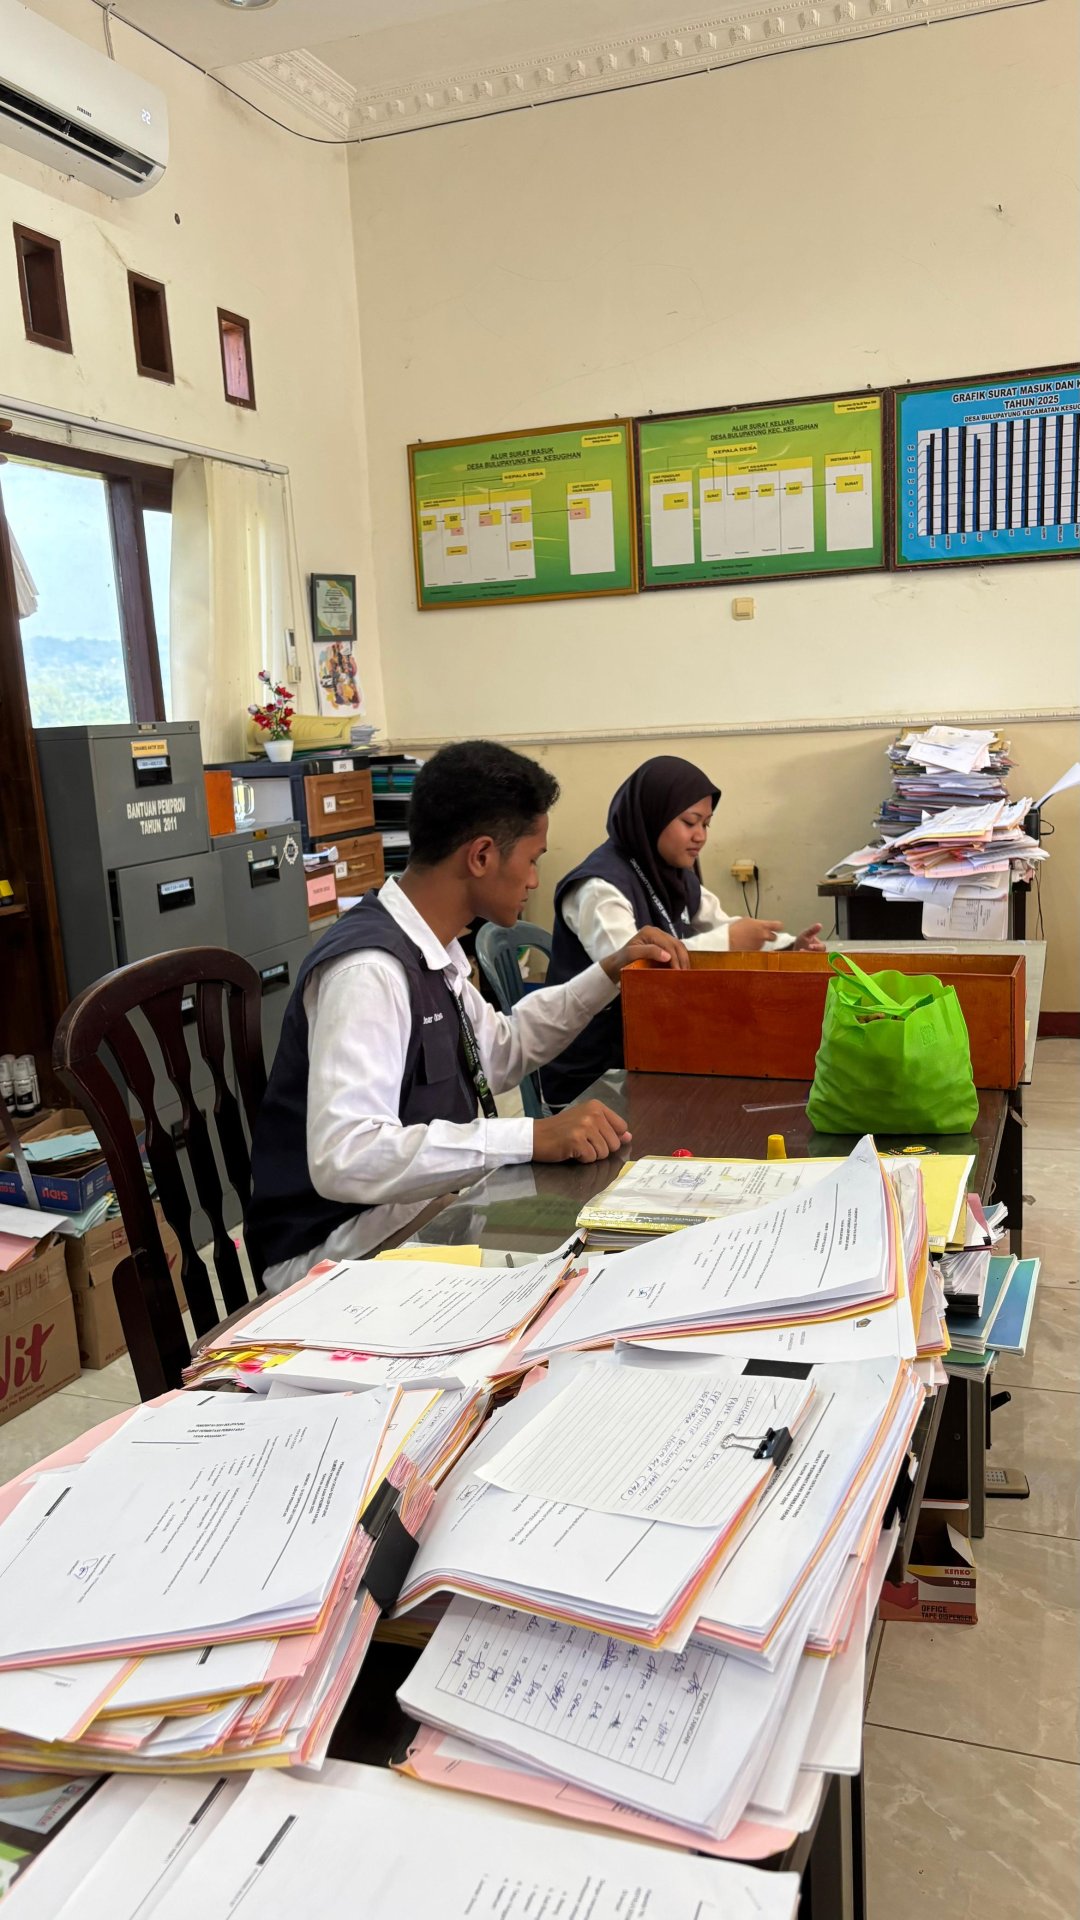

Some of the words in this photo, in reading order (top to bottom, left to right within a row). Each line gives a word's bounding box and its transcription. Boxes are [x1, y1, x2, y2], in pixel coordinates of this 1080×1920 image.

[141, 108, 151, 125] 22
[953, 391, 985, 402] GRAFIK
[988, 388, 1017, 398] SURAT
[1020, 382, 1053, 394] MASUK
[1055, 380, 1074, 390] DAN
[1004, 398, 1035, 409] TAHUN
[1037, 395, 1059, 405] 2025
[982, 411, 1021, 420] BULUPAYUNG
[1022, 406, 1060, 416] KECAMATAN
[728, 428, 767, 439] BULUPAYUNG
[783, 424, 819, 432] KESUGIHAN
[749, 422, 768, 430] SURAT
[770, 419, 794, 427] KELUAR
[509, 450, 530, 459] SURAT
[531, 447, 554, 456] MASUK
[466, 463, 483, 471] DESA
[485, 458, 526, 469] BULUPAYUNG
[528, 456, 541, 464] KEC.
[544, 452, 581, 462] KESUGIHAN
[126, 800, 157, 819] BANTUAN
[158, 797, 186, 815] PEMPROV
[140, 819, 161, 835] TAHUN
[163, 816, 178, 832] 2011
[922, 1604, 948, 1613] OFFICE
[938, 1613, 973, 1622] DISPENSER
